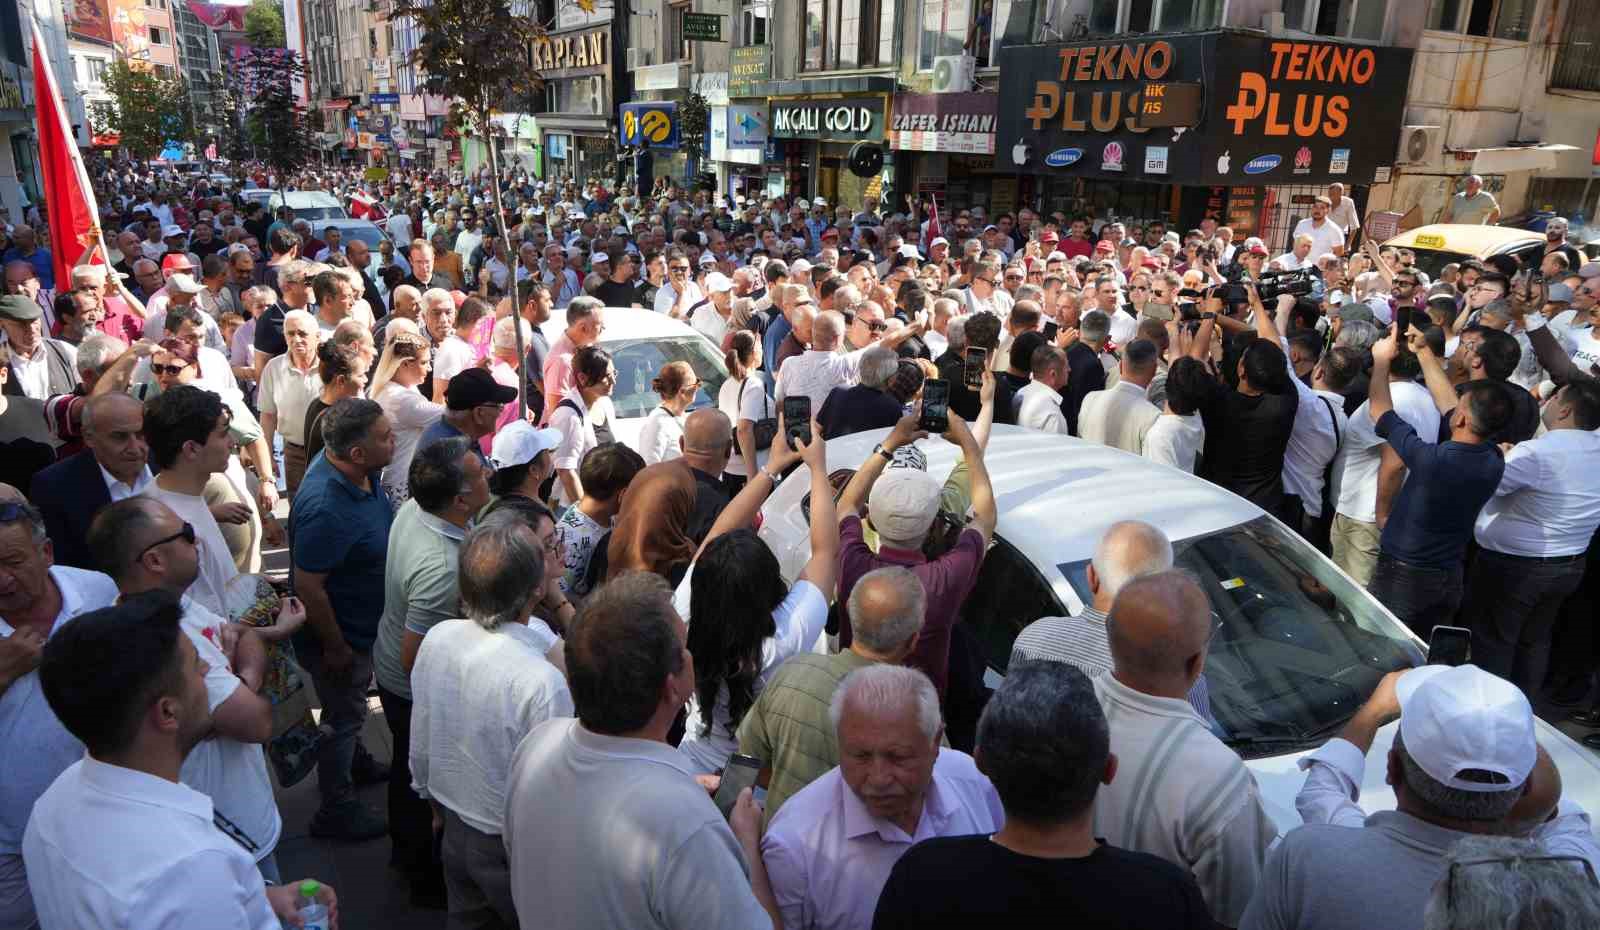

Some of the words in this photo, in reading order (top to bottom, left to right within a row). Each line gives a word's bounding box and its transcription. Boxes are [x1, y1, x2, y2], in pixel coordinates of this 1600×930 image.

[533, 31, 603, 71] KAPLAN
[1058, 41, 1172, 81] TEKNO
[1271, 43, 1375, 85] TEKNO
[774, 107, 819, 134] AKÇALI
[825, 106, 870, 132] GOLD
[893, 114, 938, 131] ZAFER
[1226, 72, 1350, 138] PLUS
[1247, 159, 1278, 169] SAMSUNG
